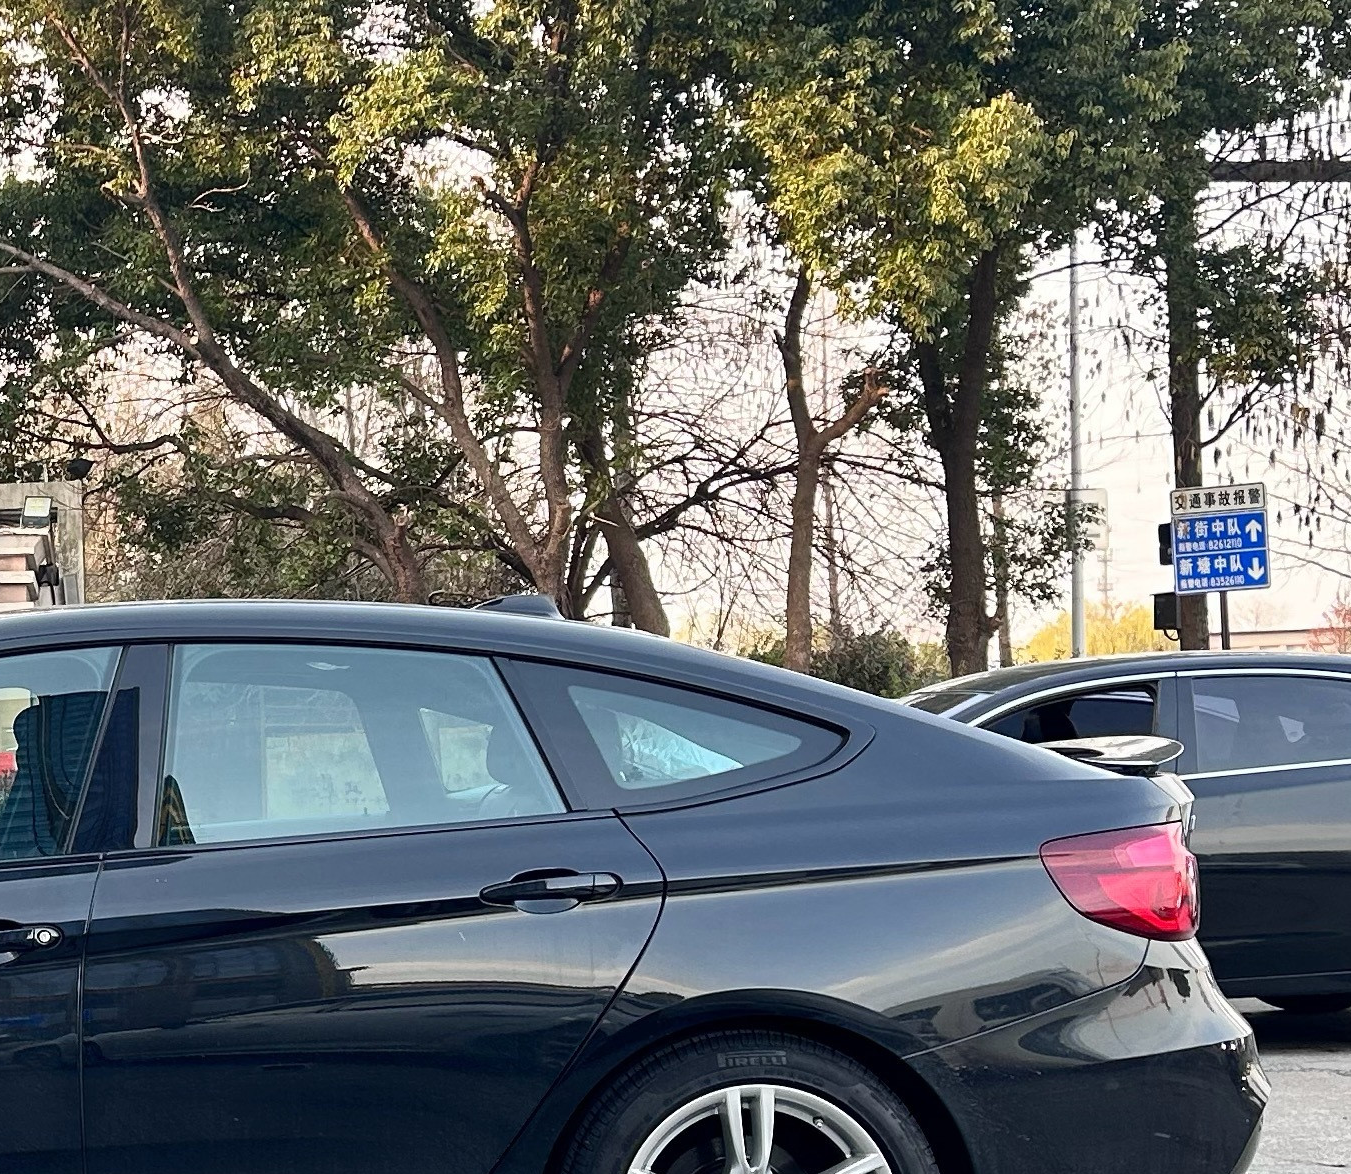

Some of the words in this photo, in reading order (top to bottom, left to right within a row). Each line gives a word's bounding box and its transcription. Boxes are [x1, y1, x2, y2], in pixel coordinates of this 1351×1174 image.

[1174, 487, 1261, 510] 交通事故报警
[1176, 517, 1242, 540] 新街中队
[1179, 553, 1244, 576] 新塘中队
[716, 1050, 788, 1068] PIRELLI
